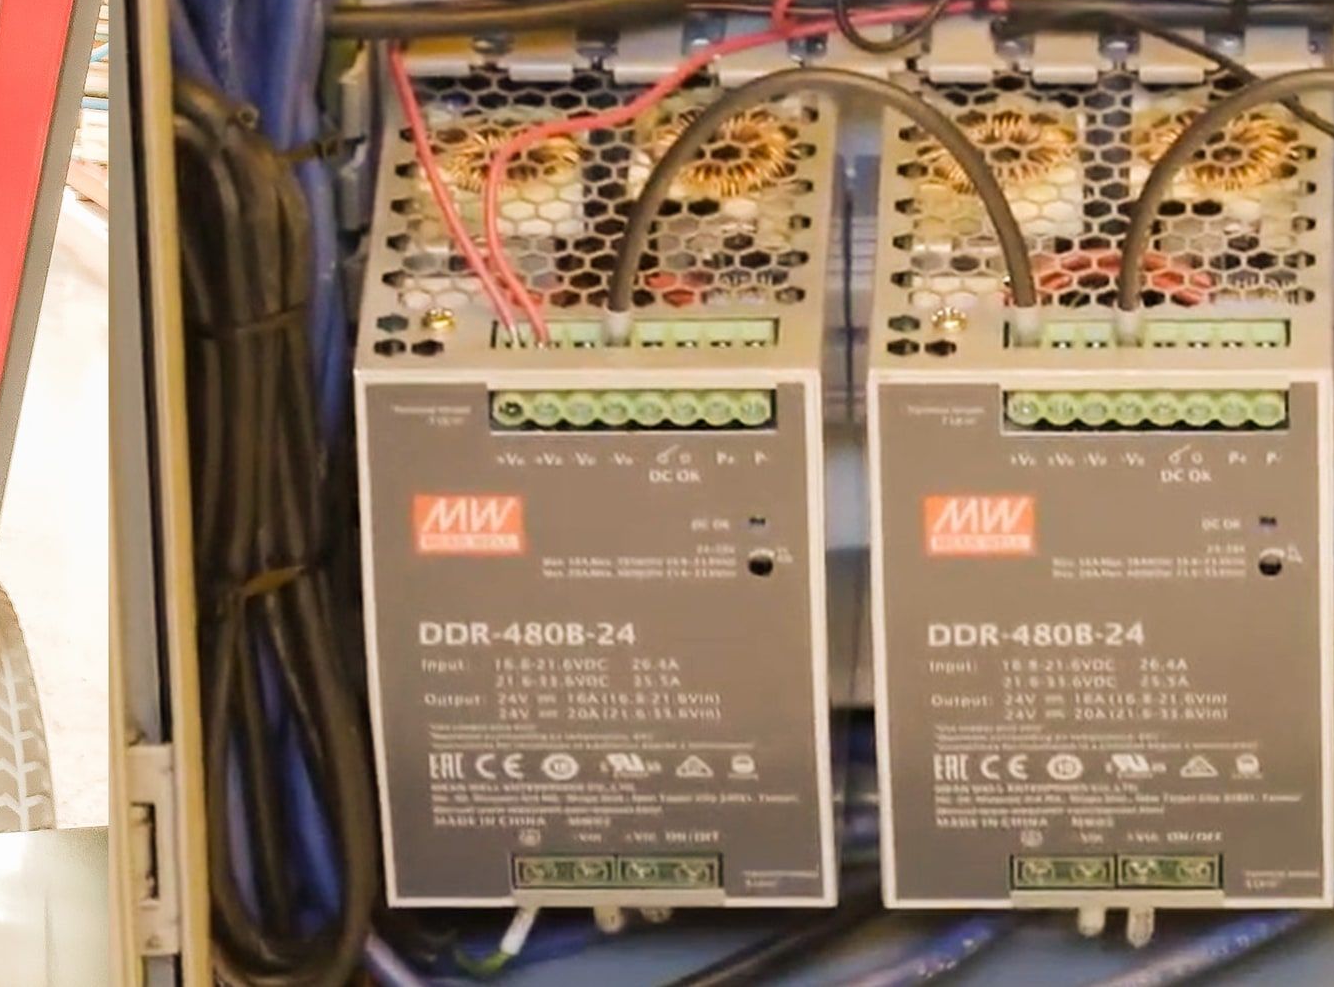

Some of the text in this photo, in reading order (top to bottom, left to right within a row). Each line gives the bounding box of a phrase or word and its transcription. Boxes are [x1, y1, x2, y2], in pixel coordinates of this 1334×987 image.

[649, 470, 672, 483] DC
[1160, 470, 1183, 483] DC
[418, 621, 636, 646] DDR-480B-24
[928, 621, 1145, 647] DDR-480B-24
